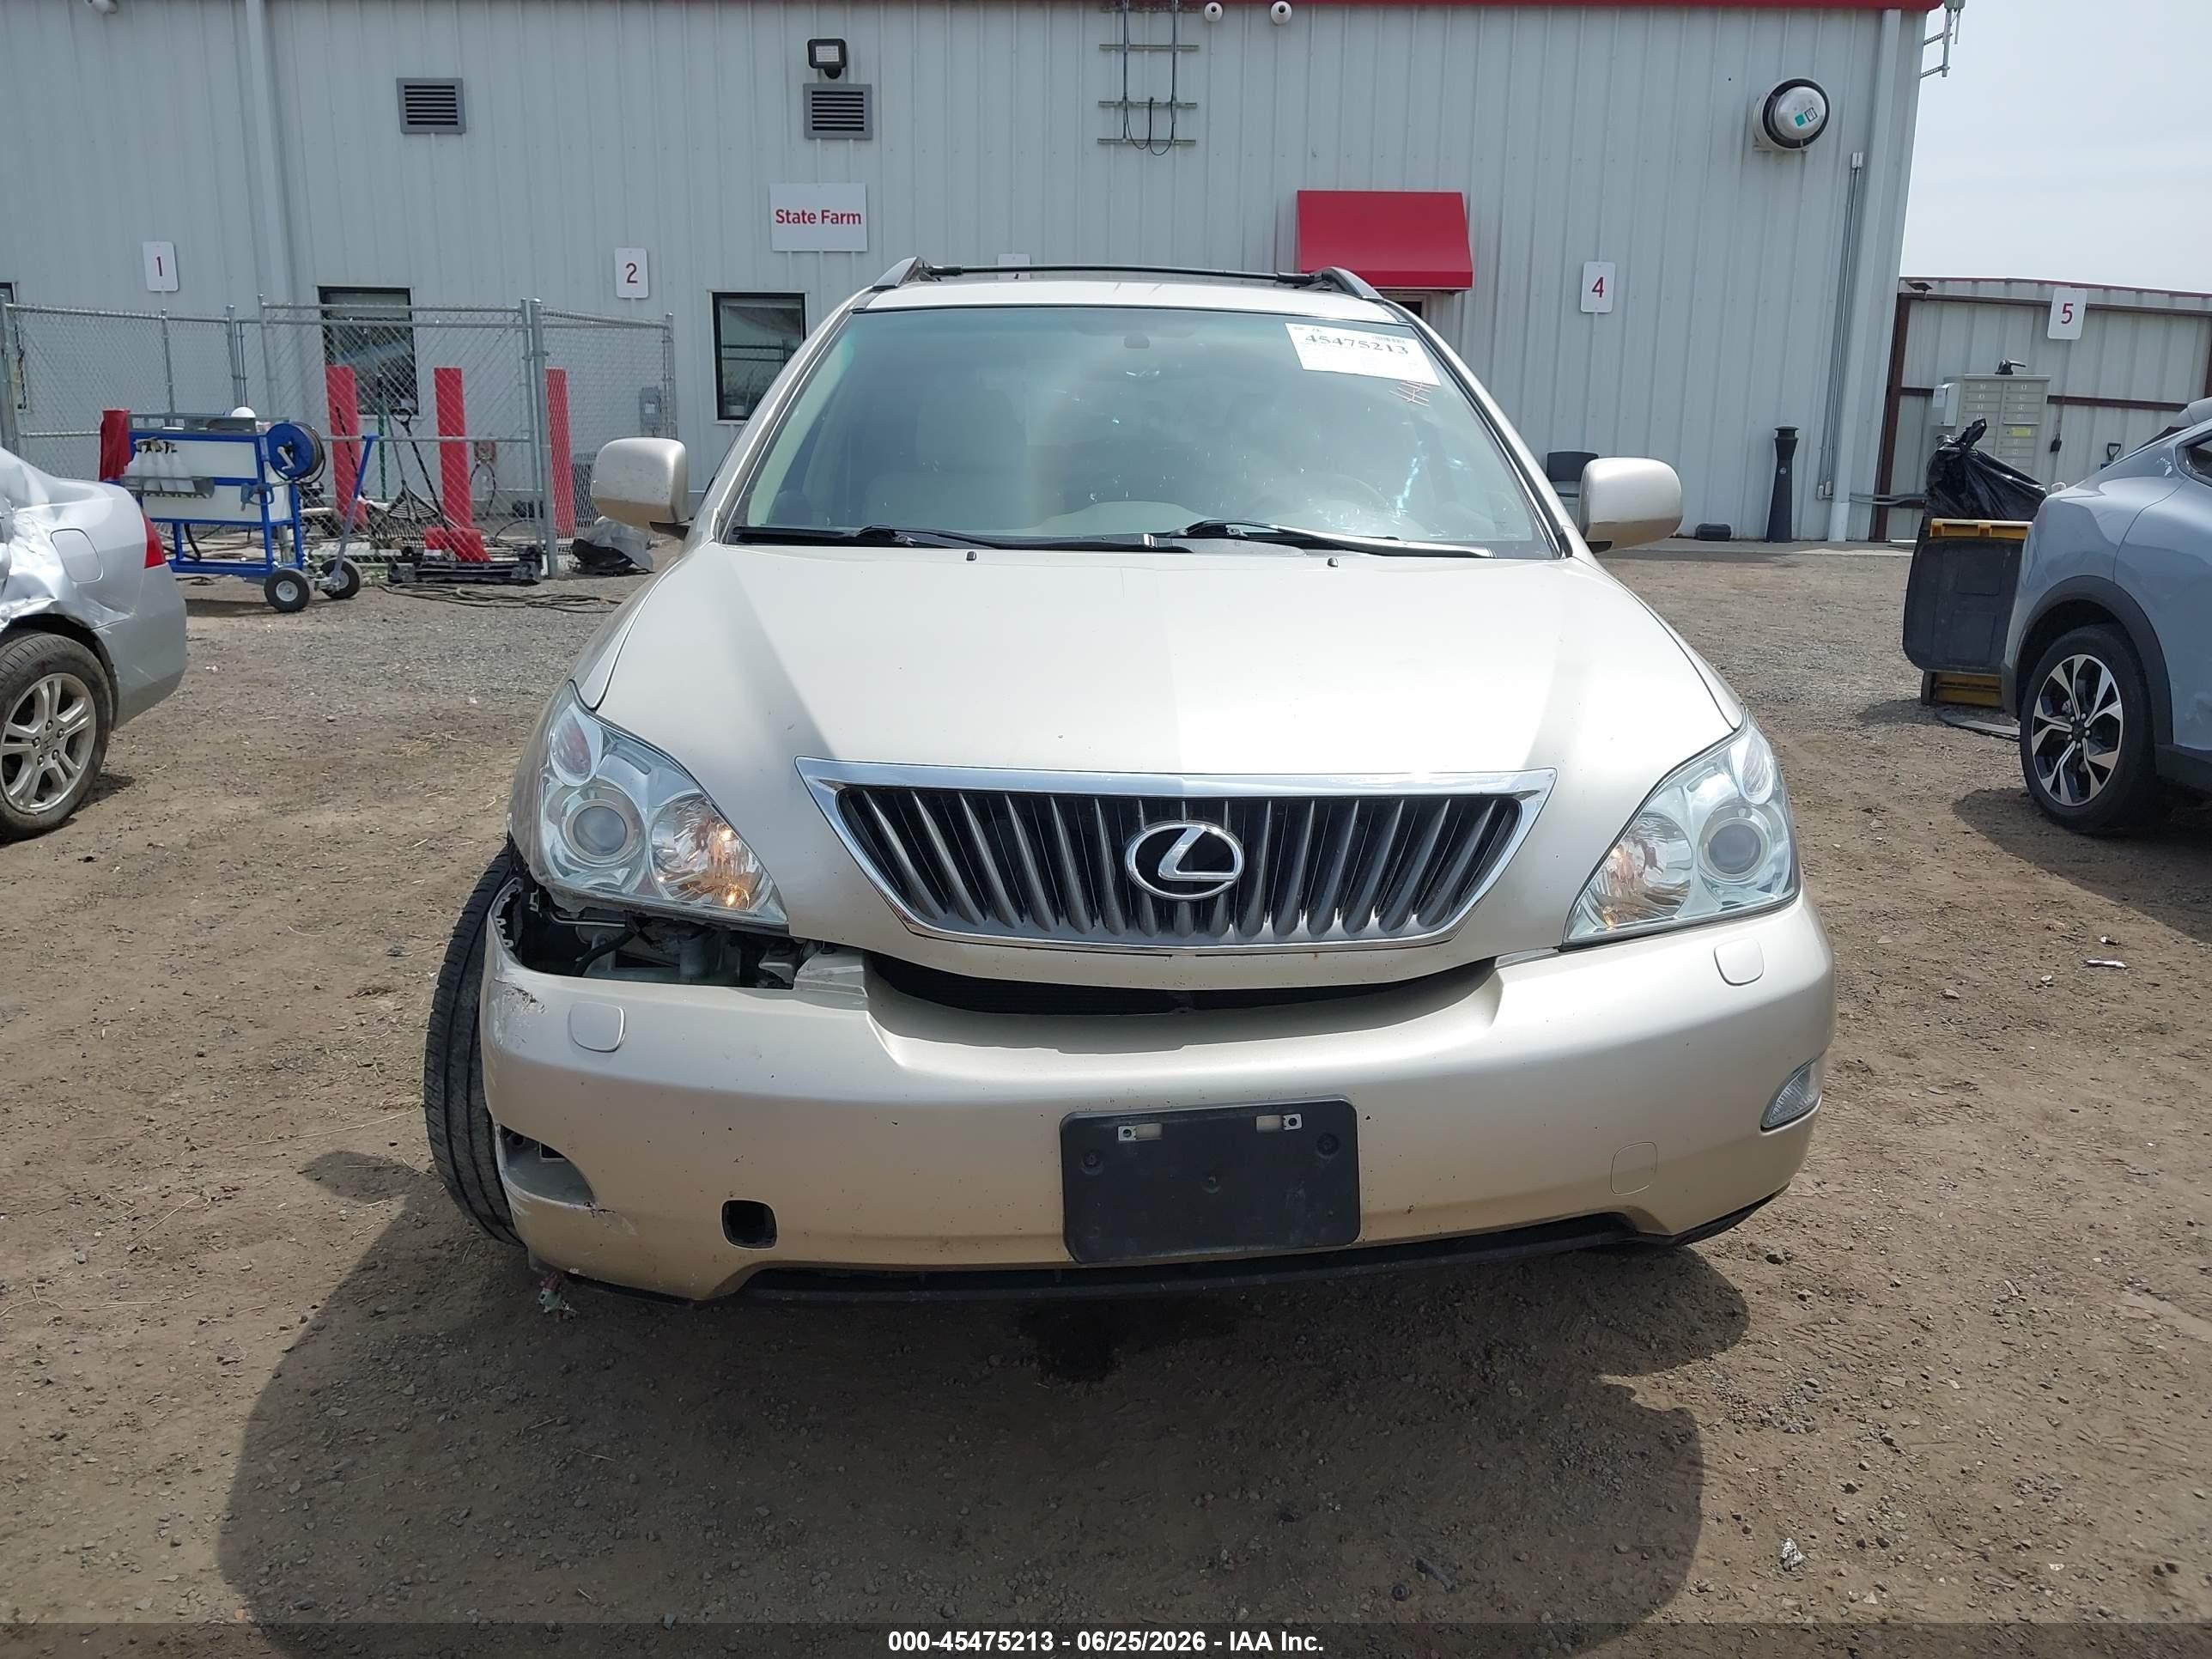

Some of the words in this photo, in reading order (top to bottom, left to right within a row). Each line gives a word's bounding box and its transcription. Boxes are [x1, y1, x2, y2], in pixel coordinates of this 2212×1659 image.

[775, 209, 817, 224] State
[821, 210, 862, 225] Farm
[156, 256, 163, 276] 1
[625, 262, 638, 283] 2
[1591, 276, 1604, 298] 4
[2061, 302, 2074, 325] 5
[1305, 334, 1409, 355] 45475213
